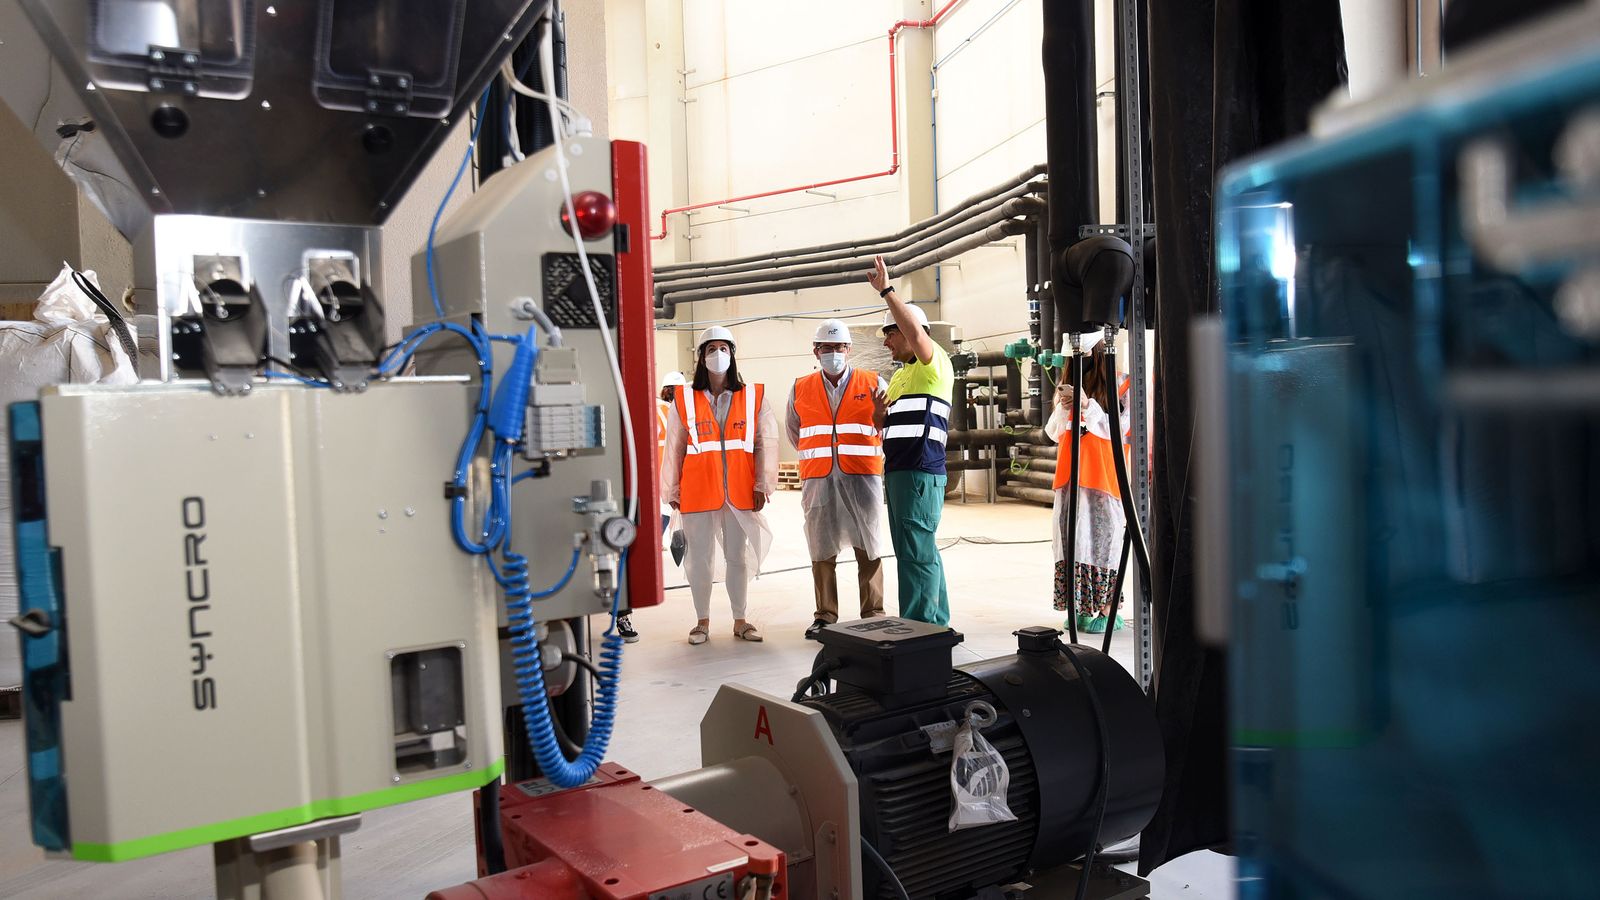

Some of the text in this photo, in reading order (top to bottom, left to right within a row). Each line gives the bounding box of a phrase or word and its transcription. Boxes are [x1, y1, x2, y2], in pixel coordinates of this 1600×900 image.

[182, 496, 217, 711] SYNCRO
[754, 704, 774, 746] A
[703, 880, 726, 900] CE
